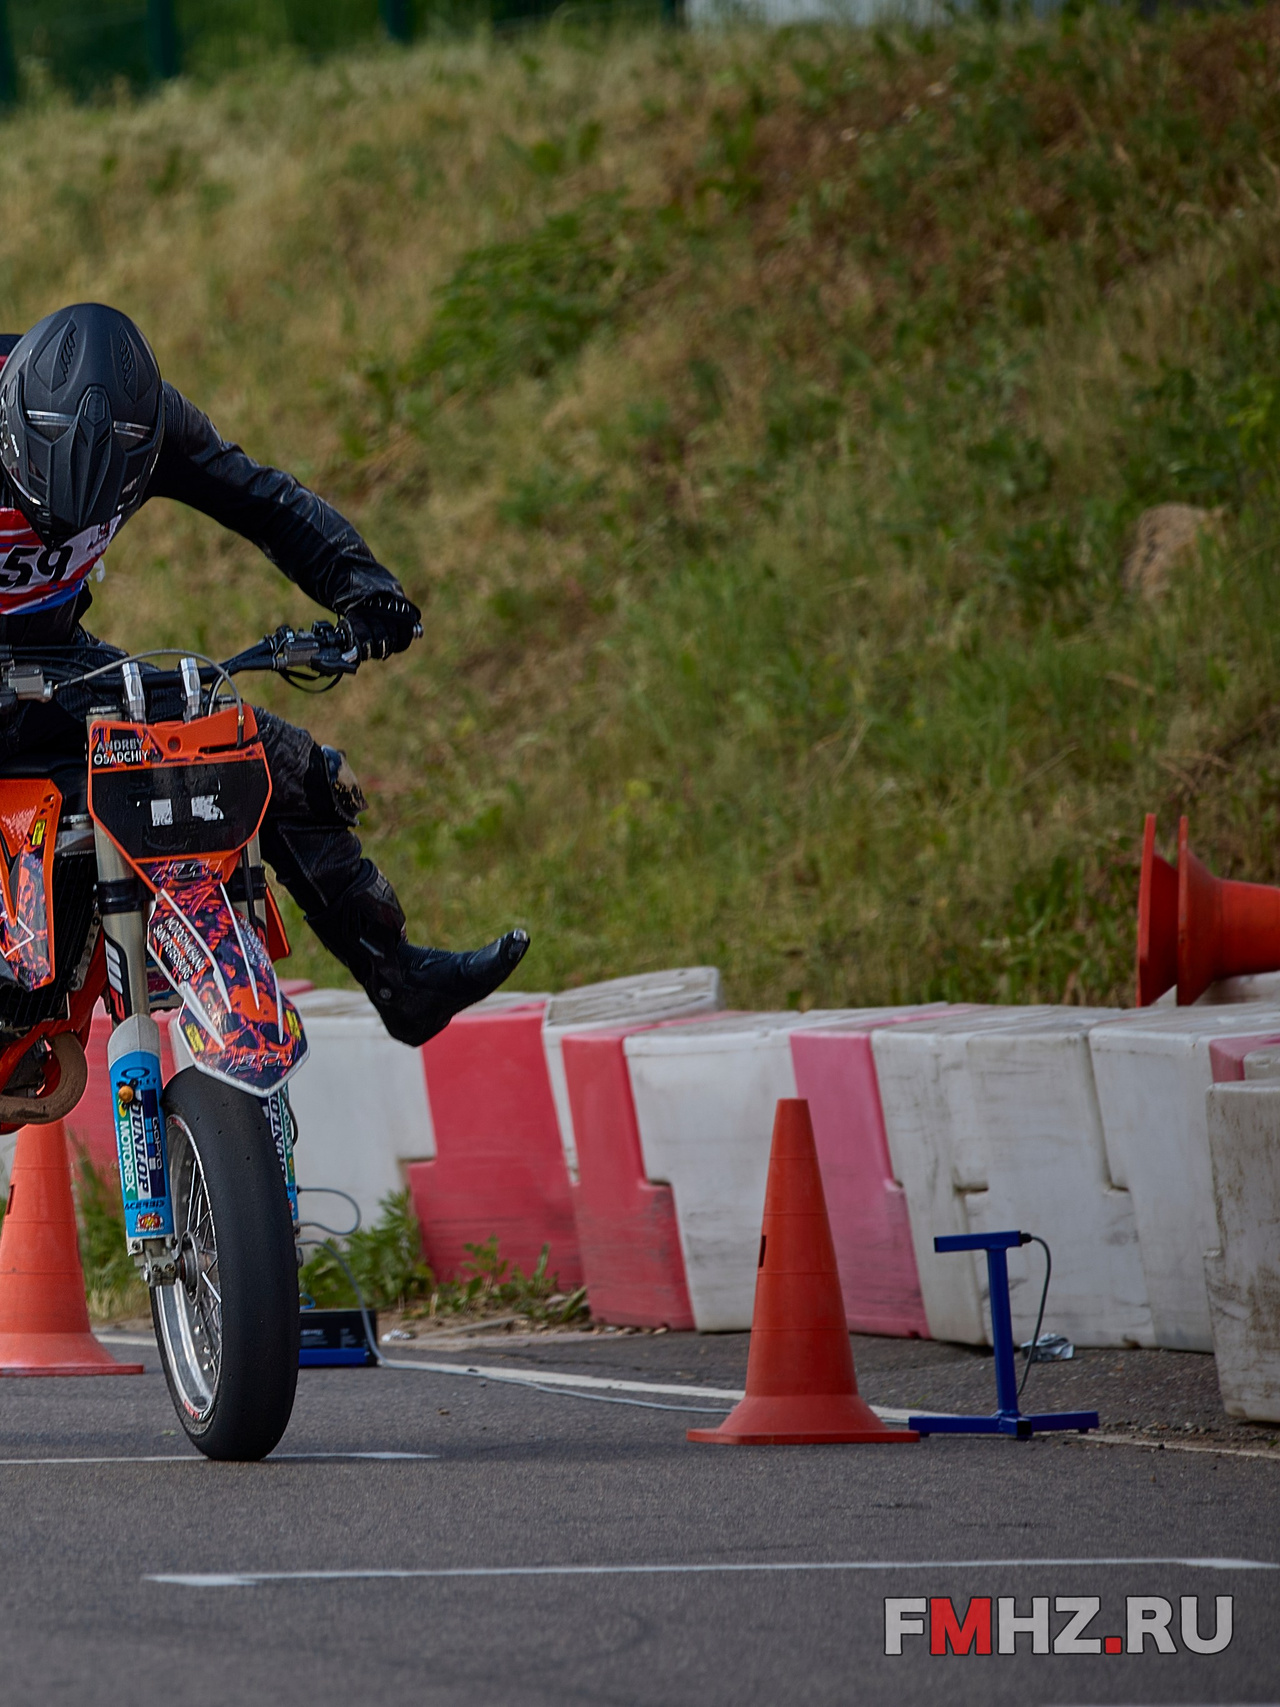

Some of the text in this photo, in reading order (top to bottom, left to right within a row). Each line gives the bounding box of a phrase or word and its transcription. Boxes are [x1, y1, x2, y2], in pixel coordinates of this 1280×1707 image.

[97, 738, 144, 753] ANDREY
[93, 749, 149, 765] OSADCHIY
[120, 1120, 135, 1194] MOTOREX
